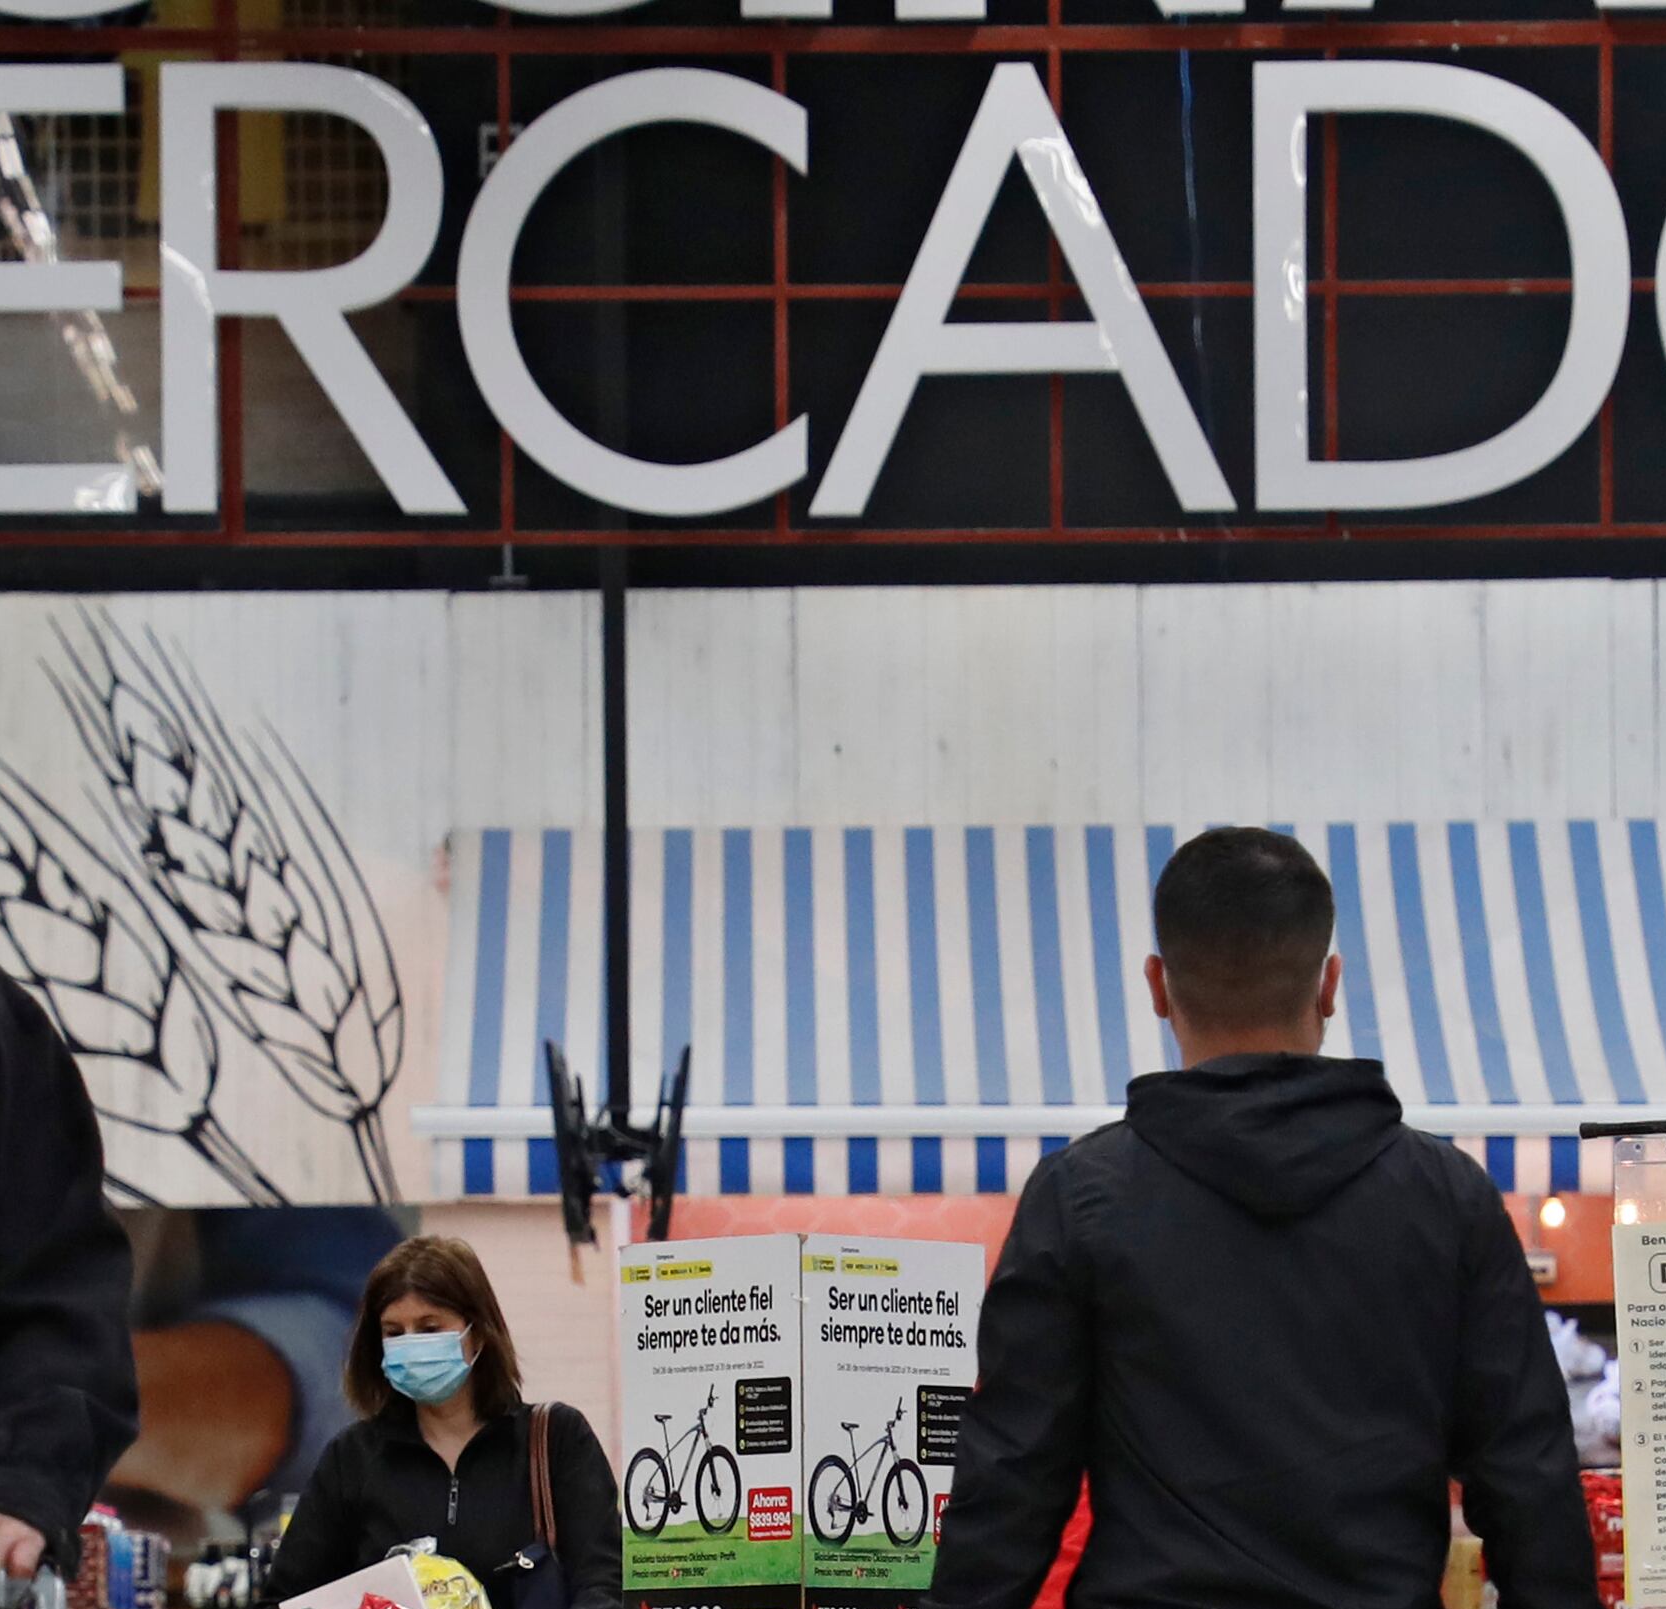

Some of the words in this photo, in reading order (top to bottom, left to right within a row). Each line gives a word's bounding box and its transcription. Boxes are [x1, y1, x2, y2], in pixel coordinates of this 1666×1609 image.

[644, 1294, 670, 1319] Ser
[673, 1297, 692, 1316] un
[694, 1289, 746, 1315] cliente
[749, 1285, 773, 1311] fiel
[828, 1286, 853, 1311] Ser
[858, 1291, 877, 1311] un
[879, 1289, 933, 1315] cliente
[935, 1291, 960, 1316] fiel
[1627, 1303, 1656, 1314] Para
[637, 1326, 698, 1353] siempre
[700, 1325, 717, 1347] te
[719, 1321, 740, 1345] da
[743, 1318, 781, 1344] más.
[820, 1319, 883, 1349] siempre
[885, 1320, 903, 1344] te
[906, 1322, 926, 1345] da
[929, 1322, 967, 1348] más.
[751, 1493, 788, 1509] Ahorra:
[749, 1511, 792, 1528] $839.994
